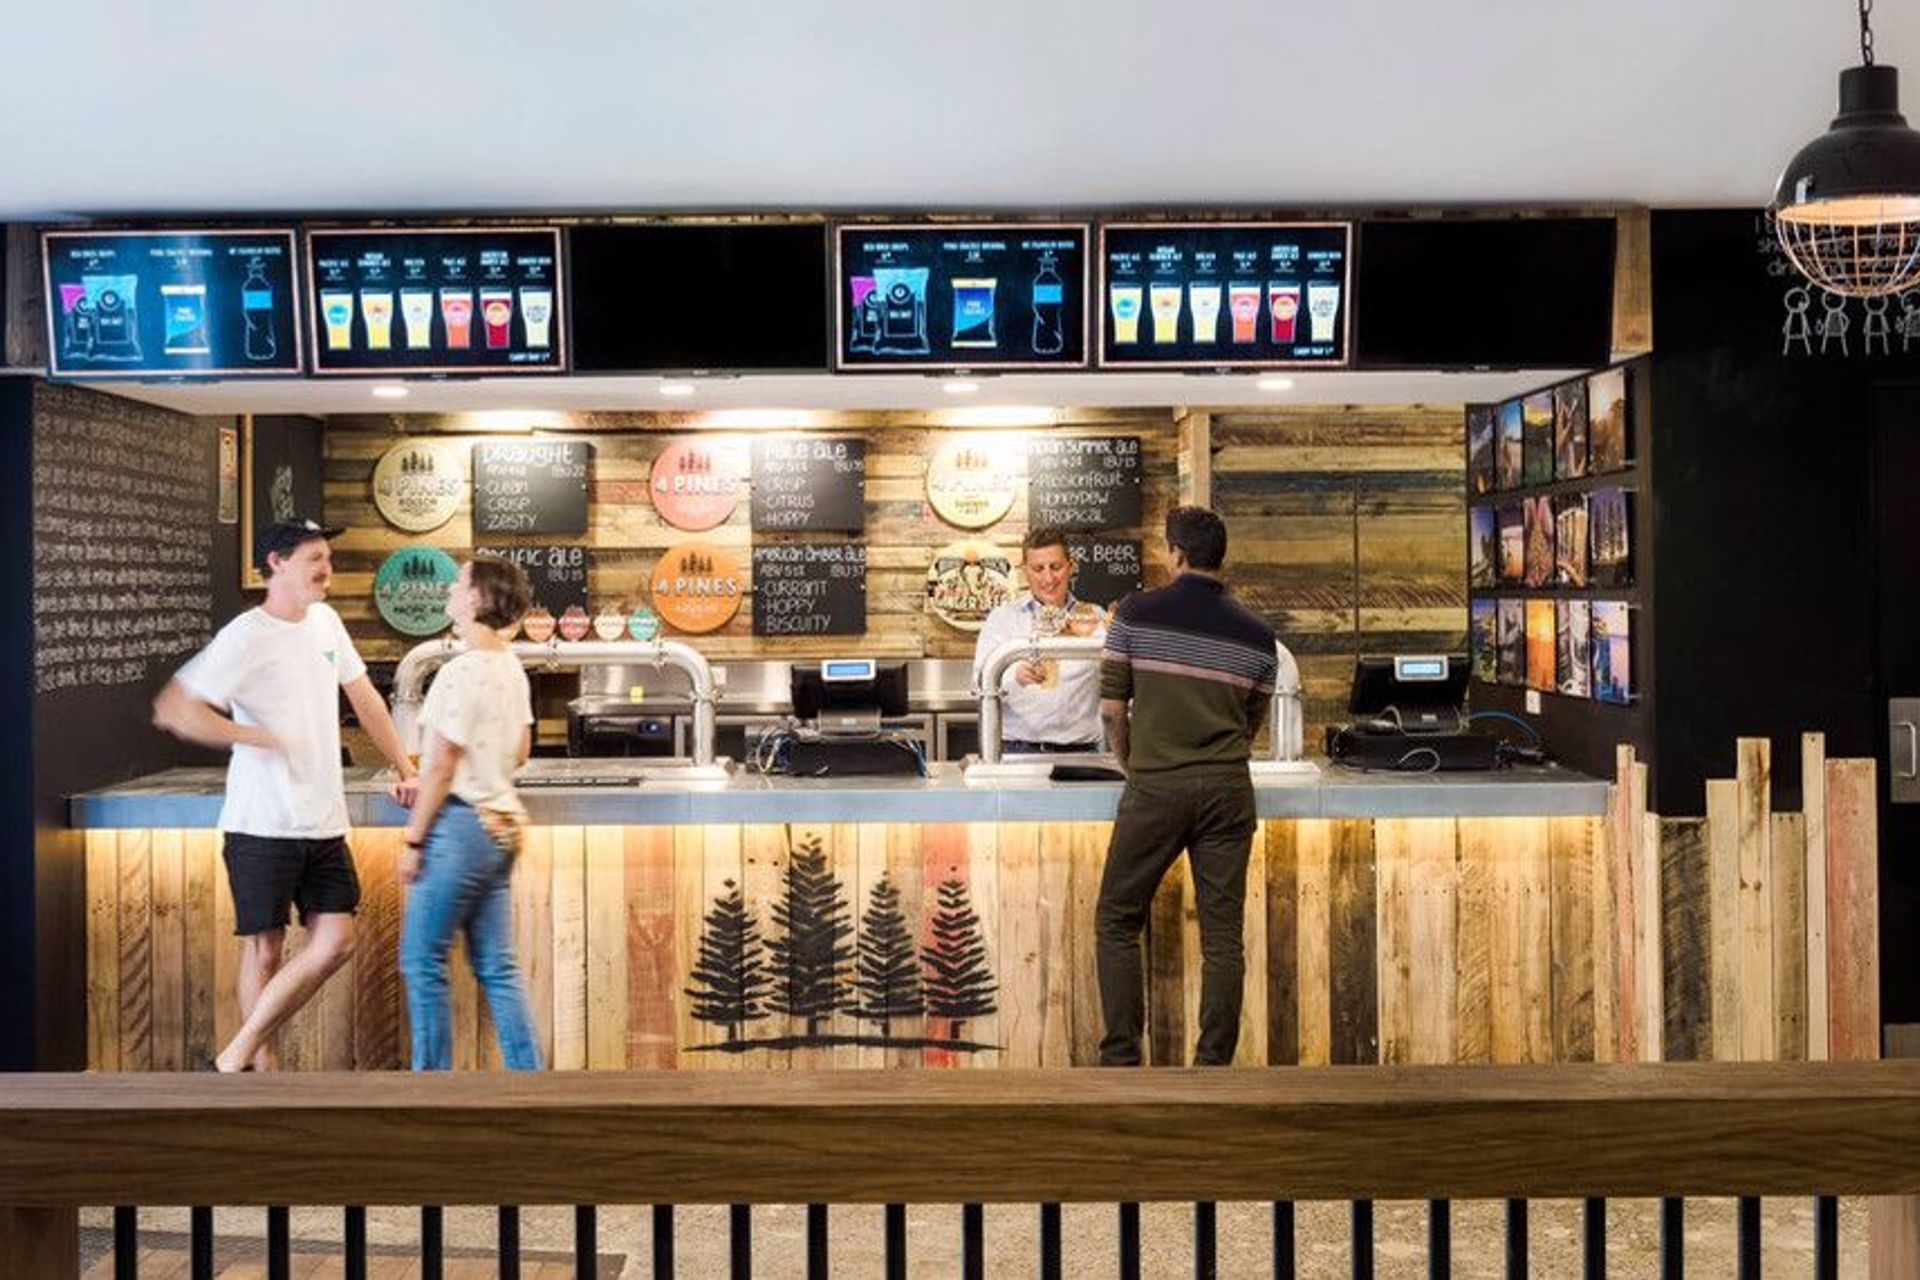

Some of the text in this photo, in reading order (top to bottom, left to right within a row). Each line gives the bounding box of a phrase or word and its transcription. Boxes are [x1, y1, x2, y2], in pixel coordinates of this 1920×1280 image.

[655, 473, 737, 495] 4 PINES
[397, 580, 451, 600] PINE
[656, 575, 738, 597] 4 PINES
